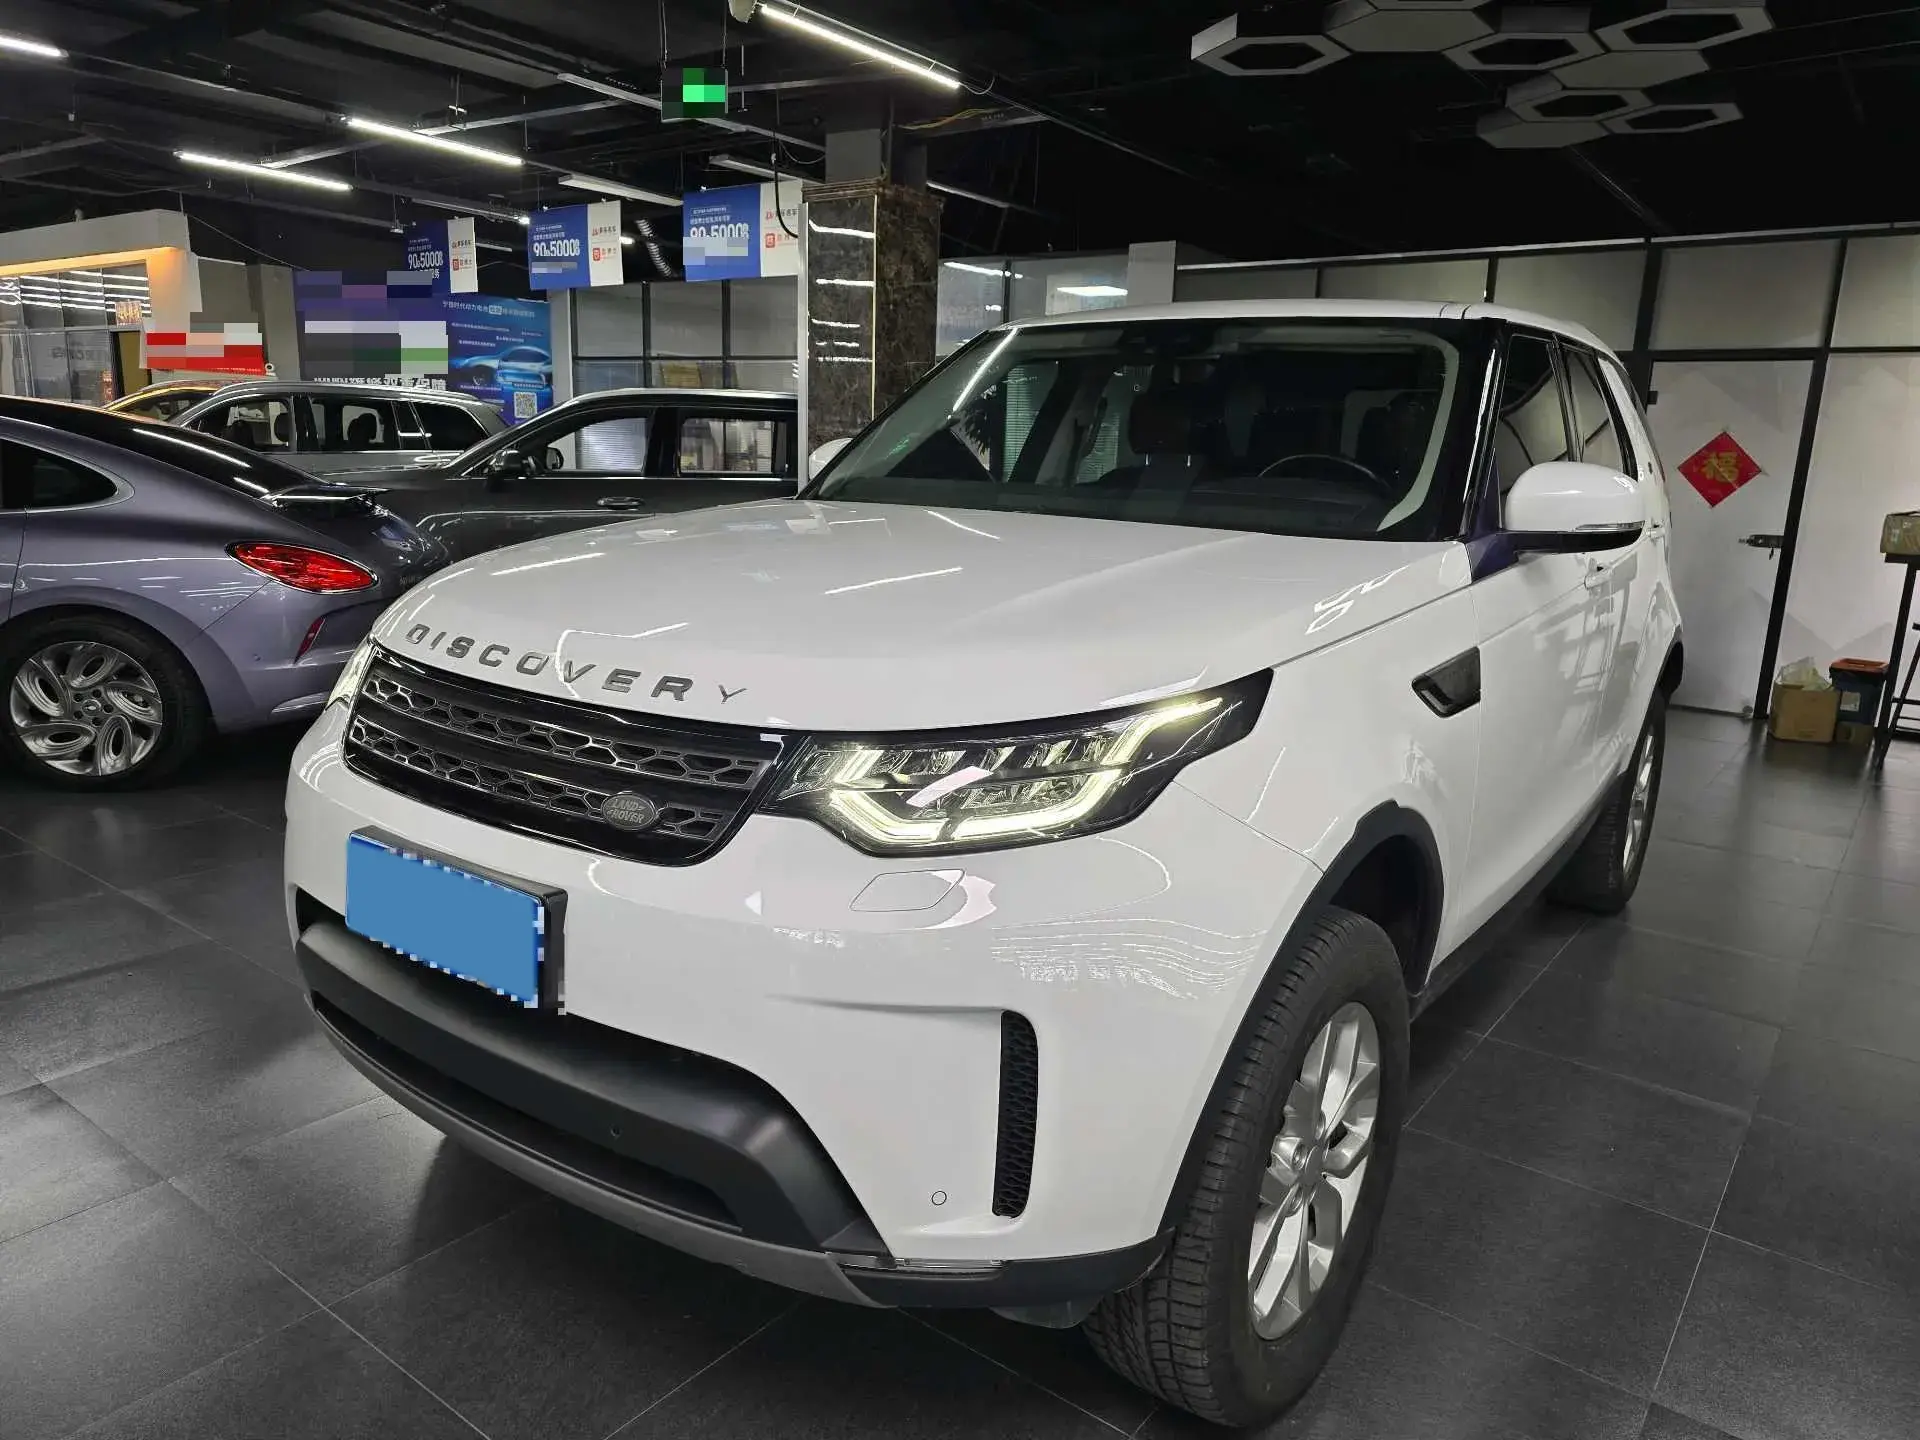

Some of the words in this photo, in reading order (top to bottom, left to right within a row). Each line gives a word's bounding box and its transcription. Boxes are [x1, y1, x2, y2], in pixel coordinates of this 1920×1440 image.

[1700, 451, 1740, 483] 福
[405, 623, 748, 704] DISCOVERY
[611, 798, 639, 811] LAND
[610, 809, 645, 824] ROVER
